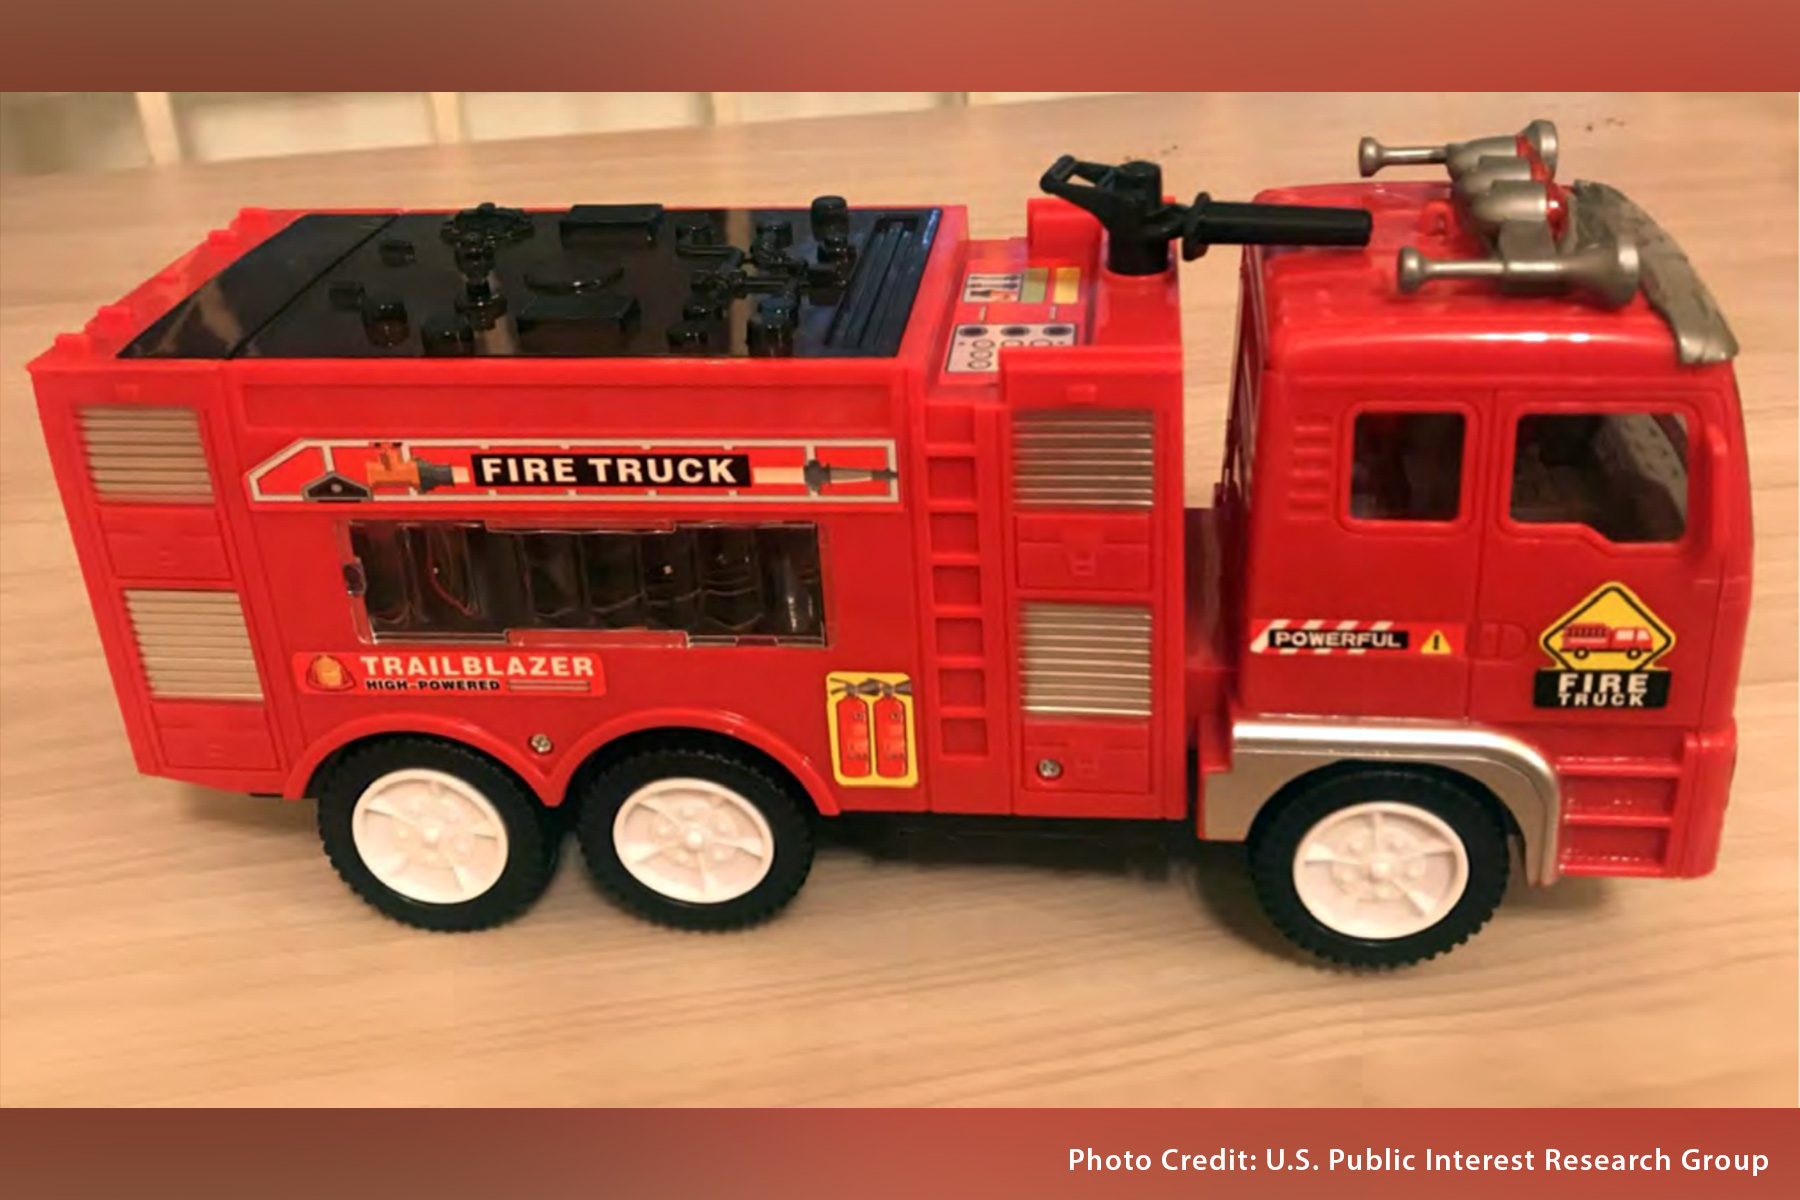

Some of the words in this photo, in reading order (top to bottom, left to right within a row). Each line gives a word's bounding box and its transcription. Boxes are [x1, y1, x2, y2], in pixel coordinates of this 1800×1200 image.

[480, 457, 577, 484] FIRE
[588, 457, 738, 484] TRUCK
[1274, 631, 1402, 648] POWERFUL
[361, 656, 595, 677] TRAILBLAZER
[365, 680, 501, 692] HIGH-POWERED
[1558, 673, 1649, 694] FIRE
[1558, 694, 1645, 707] TRUCK
